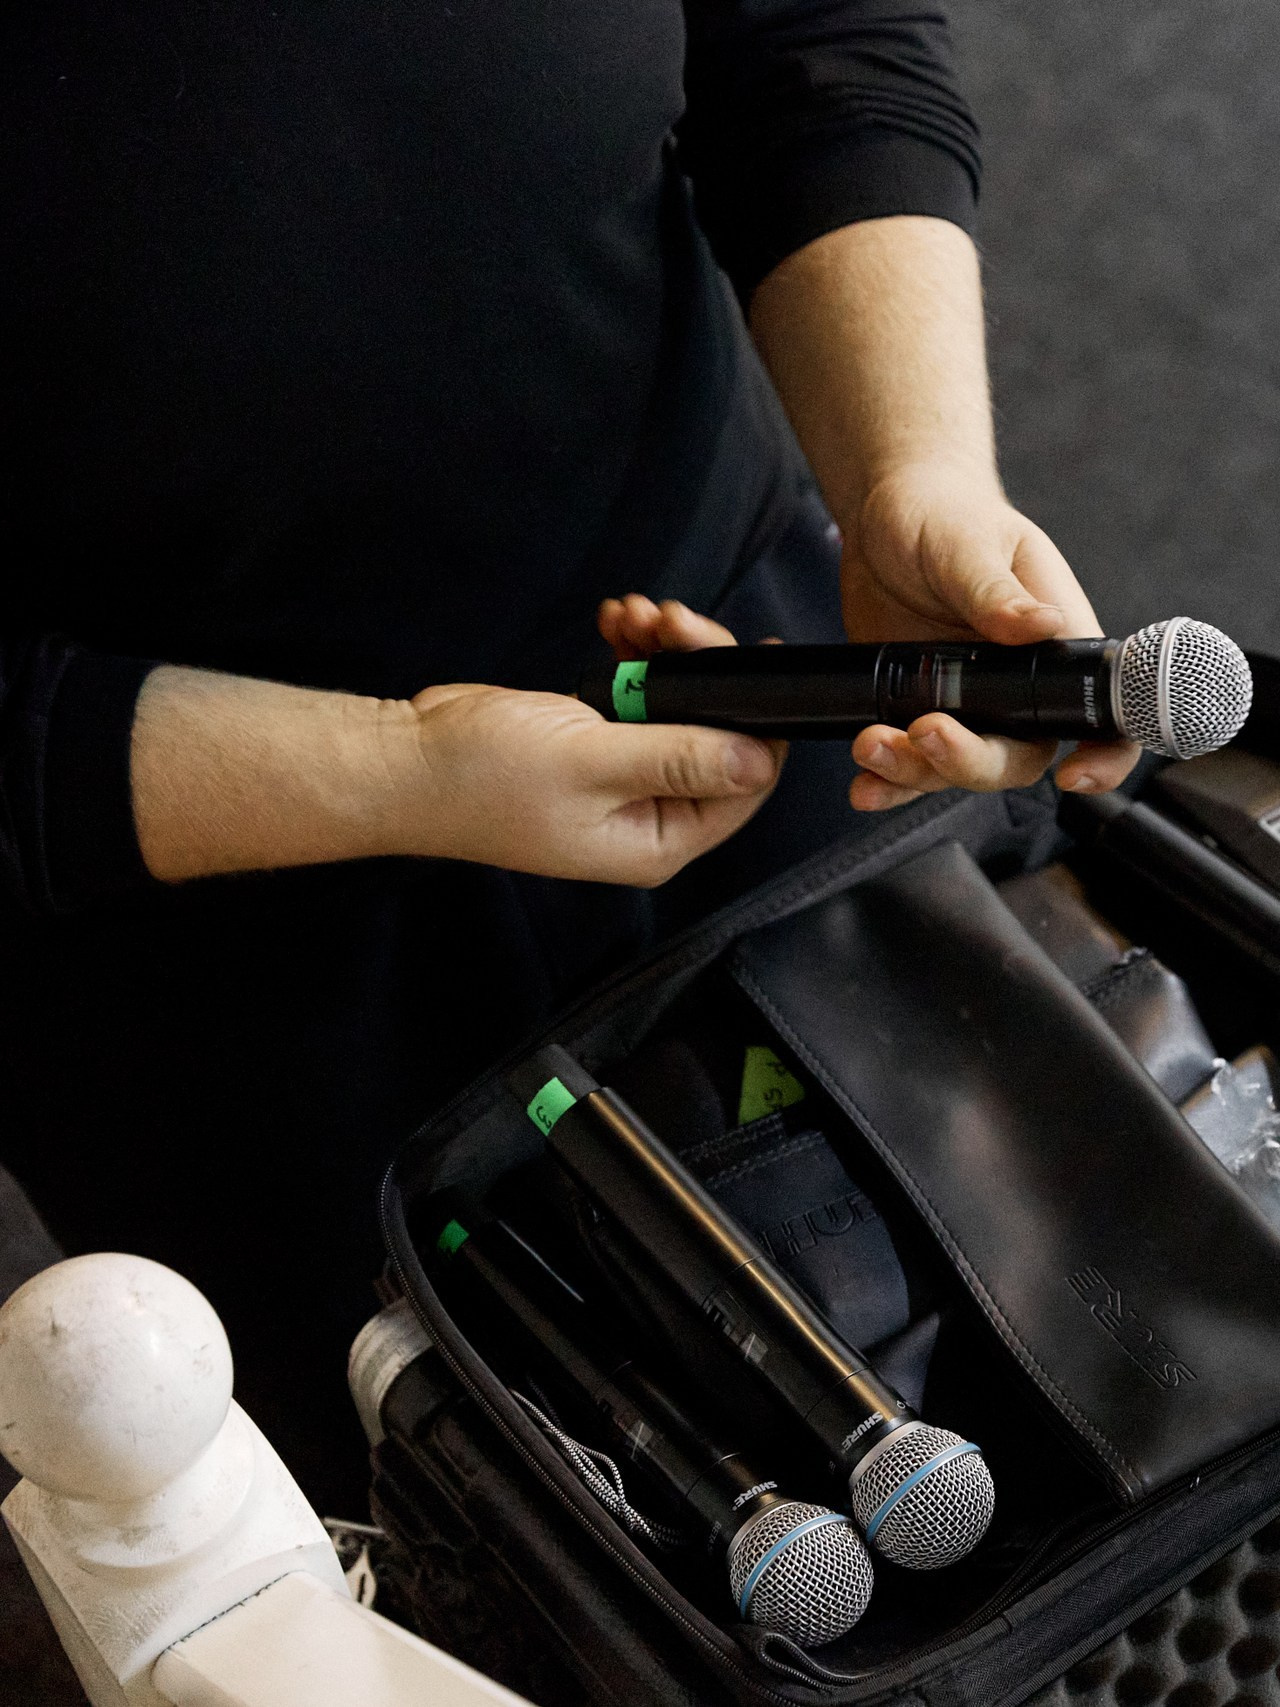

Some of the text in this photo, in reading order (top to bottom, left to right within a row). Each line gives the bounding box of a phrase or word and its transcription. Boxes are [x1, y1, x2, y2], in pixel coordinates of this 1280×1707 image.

[1083, 674, 1099, 725] SHURE
[536, 1106, 553, 1130] 3
[841, 1410, 884, 1452] SHURE
[733, 1480, 778, 1509] SHURE
